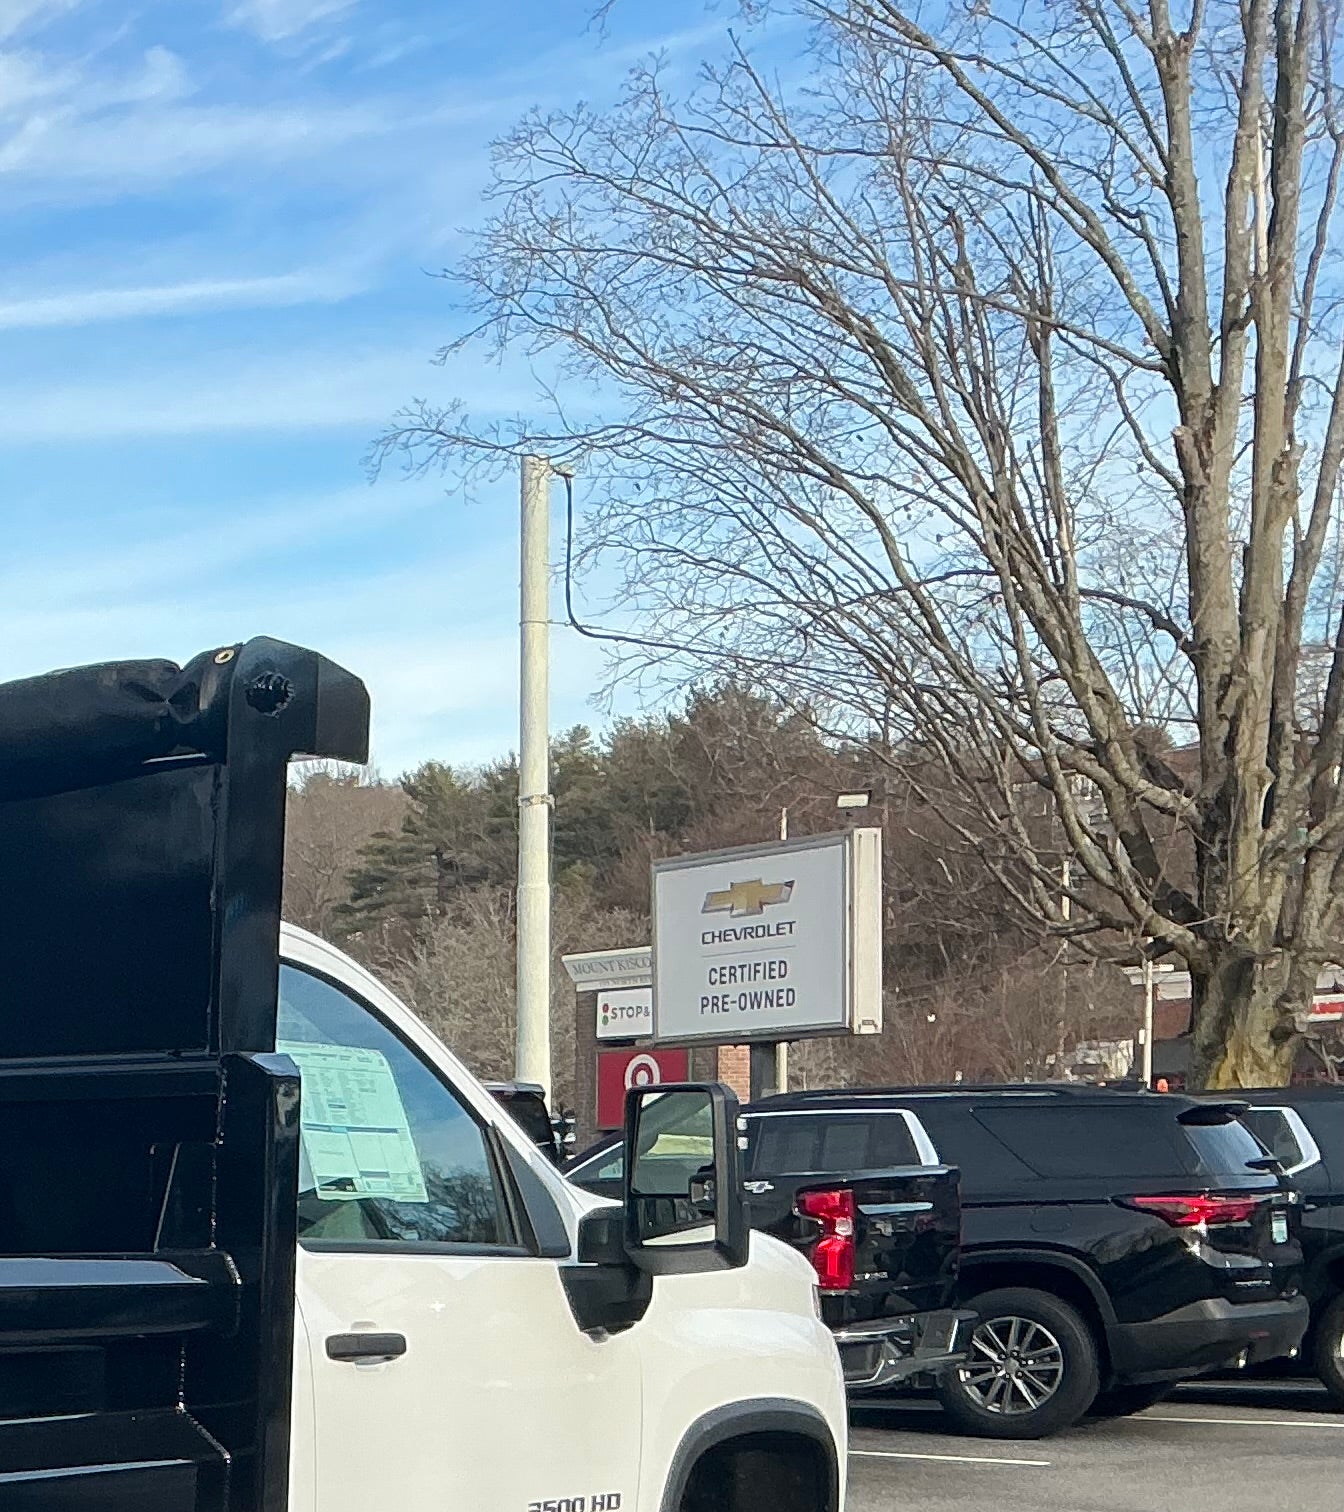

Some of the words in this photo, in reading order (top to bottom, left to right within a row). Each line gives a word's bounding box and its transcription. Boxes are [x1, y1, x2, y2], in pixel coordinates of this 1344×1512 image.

[701, 921, 797, 945] CHEVROLET
[572, 960, 616, 976] MOUNT
[708, 959, 788, 986] CERTIFIED
[699, 987, 797, 1015] PRE-OWNED
[589, 1492, 622, 1512] HD
